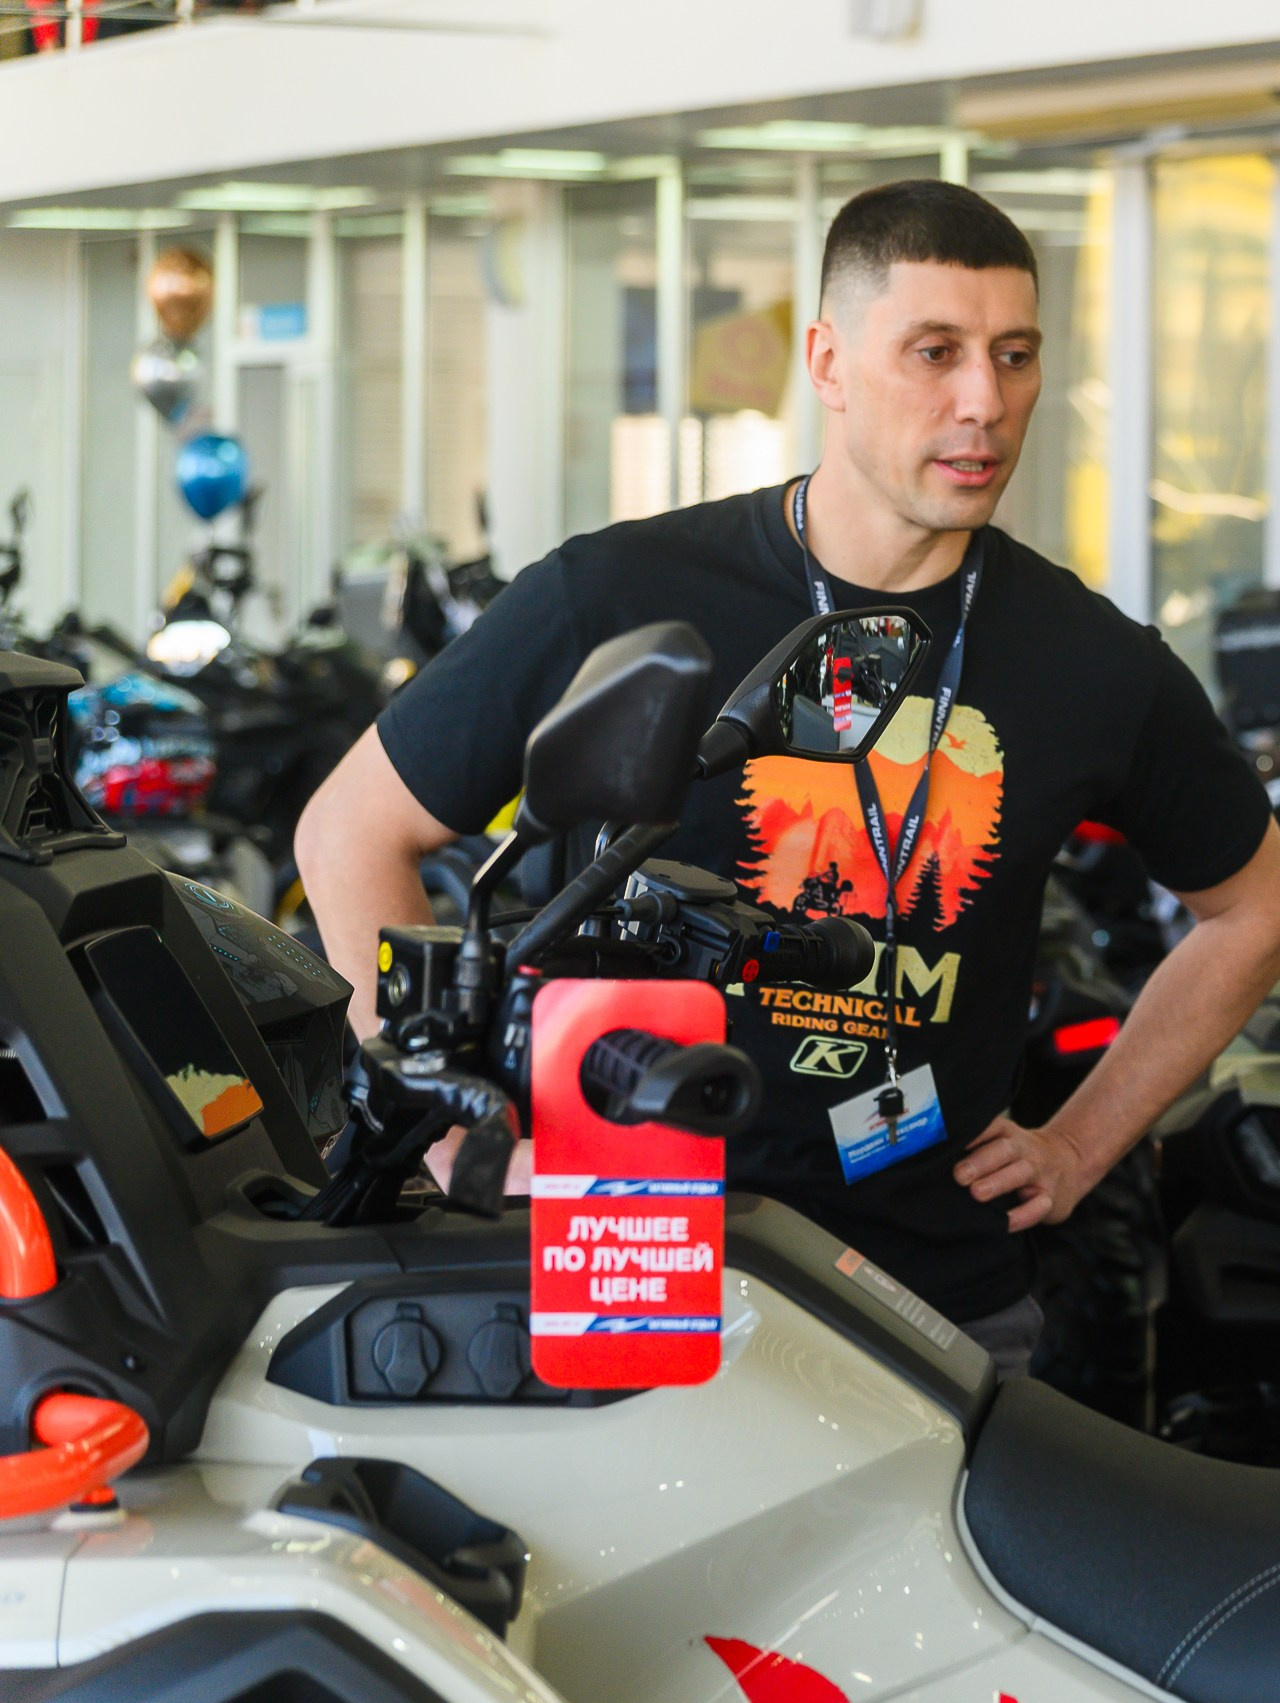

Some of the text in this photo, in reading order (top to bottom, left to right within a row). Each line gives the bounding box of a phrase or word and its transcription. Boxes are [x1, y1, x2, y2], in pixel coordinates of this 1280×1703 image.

[771, 1012, 838, 1032] RIDING
[567, 1215, 689, 1242] ЛУЧШЕЕ
[543, 1241, 714, 1272] ПО ЛУЧШЕЙ
[590, 1276, 667, 1306] ЦЕНЕ
